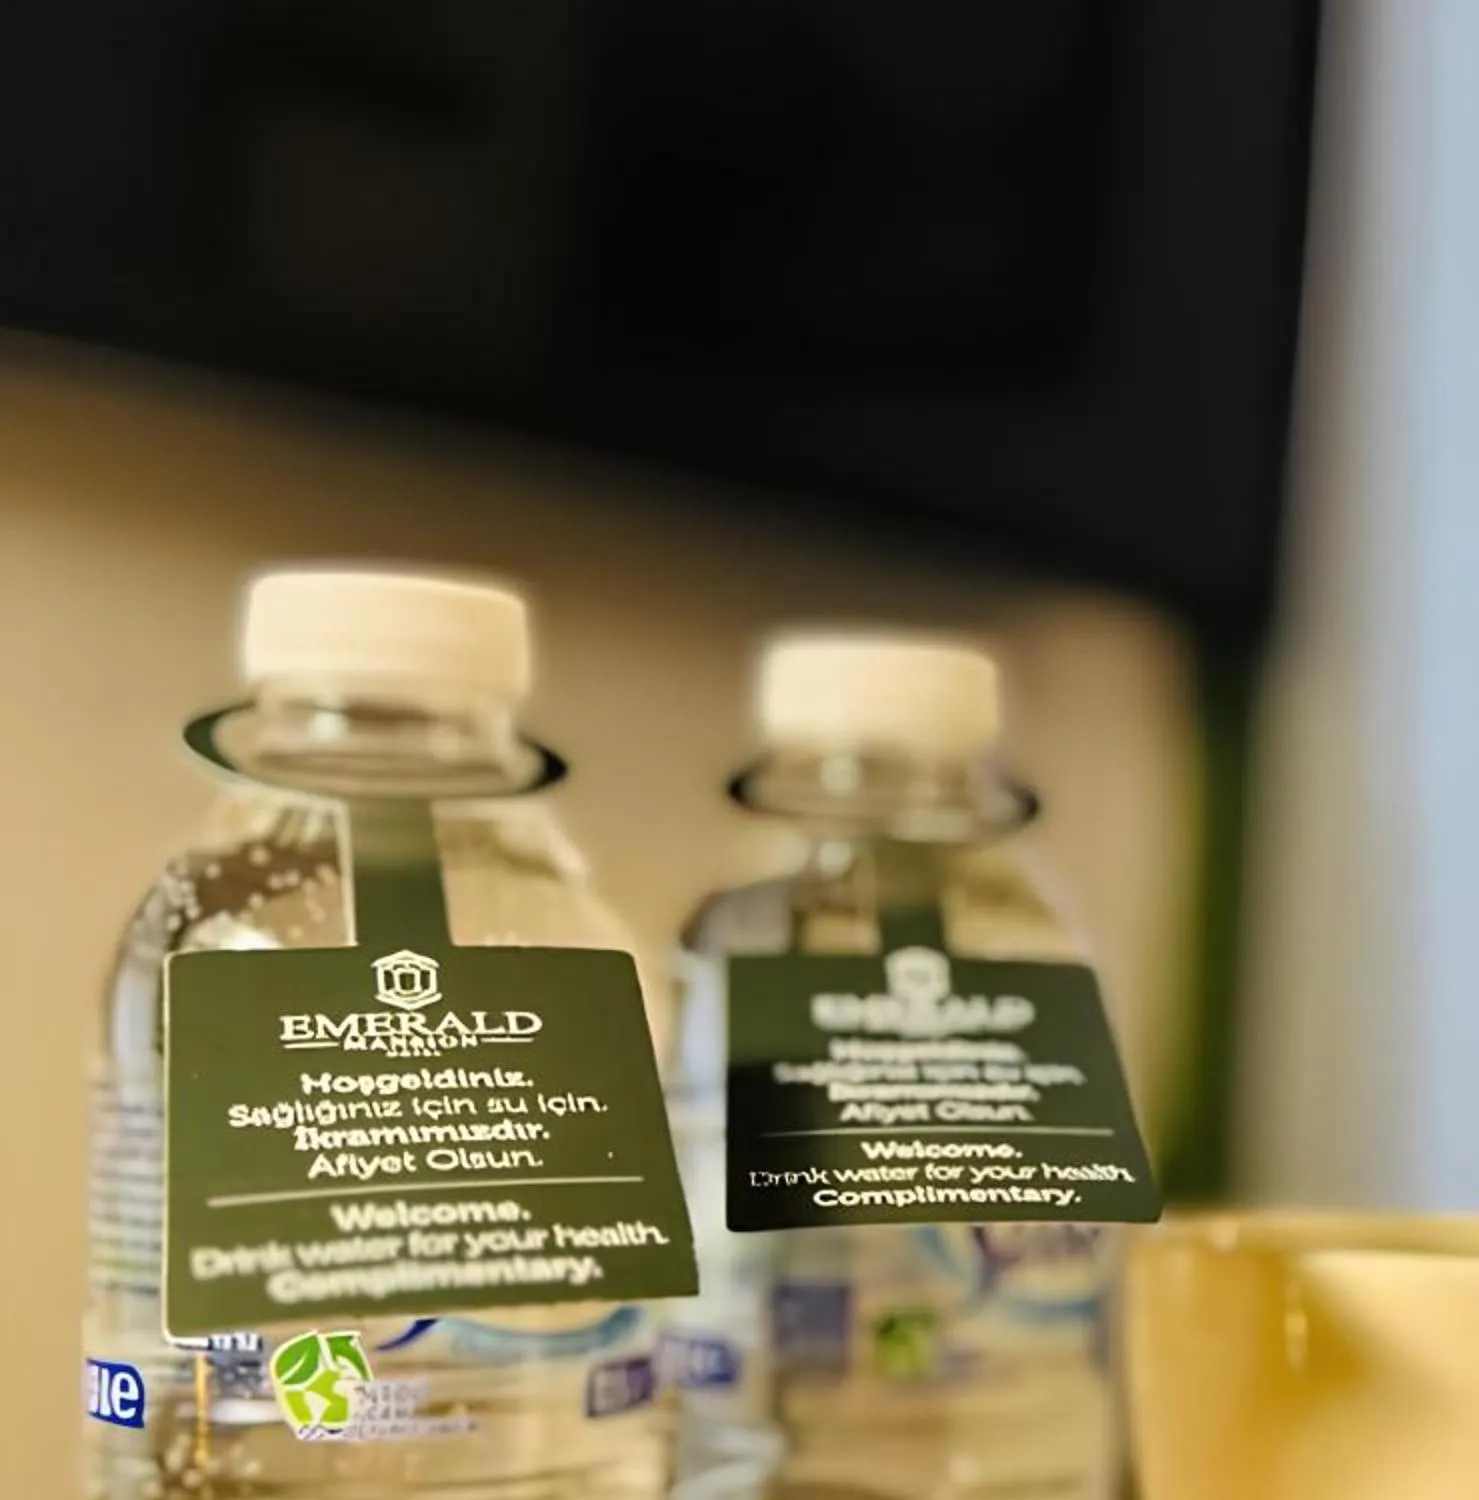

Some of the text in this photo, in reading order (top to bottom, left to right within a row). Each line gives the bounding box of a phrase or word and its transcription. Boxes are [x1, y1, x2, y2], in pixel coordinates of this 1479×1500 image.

[279, 1011, 543, 1040] EMERALD
[487, 1097, 528, 1115] su
[861, 1141, 1022, 1159] Welcome.
[307, 1148, 544, 1180] Afiyet Olsun.
[833, 1166, 916, 1183] water
[924, 1163, 961, 1182] for
[970, 1164, 1036, 1183] your
[813, 1186, 1082, 1207] Complimentary.
[329, 1199, 531, 1232] Welcome.
[298, 1234, 401, 1268] water
[408, 1229, 459, 1259] for
[464, 1226, 547, 1259] your
